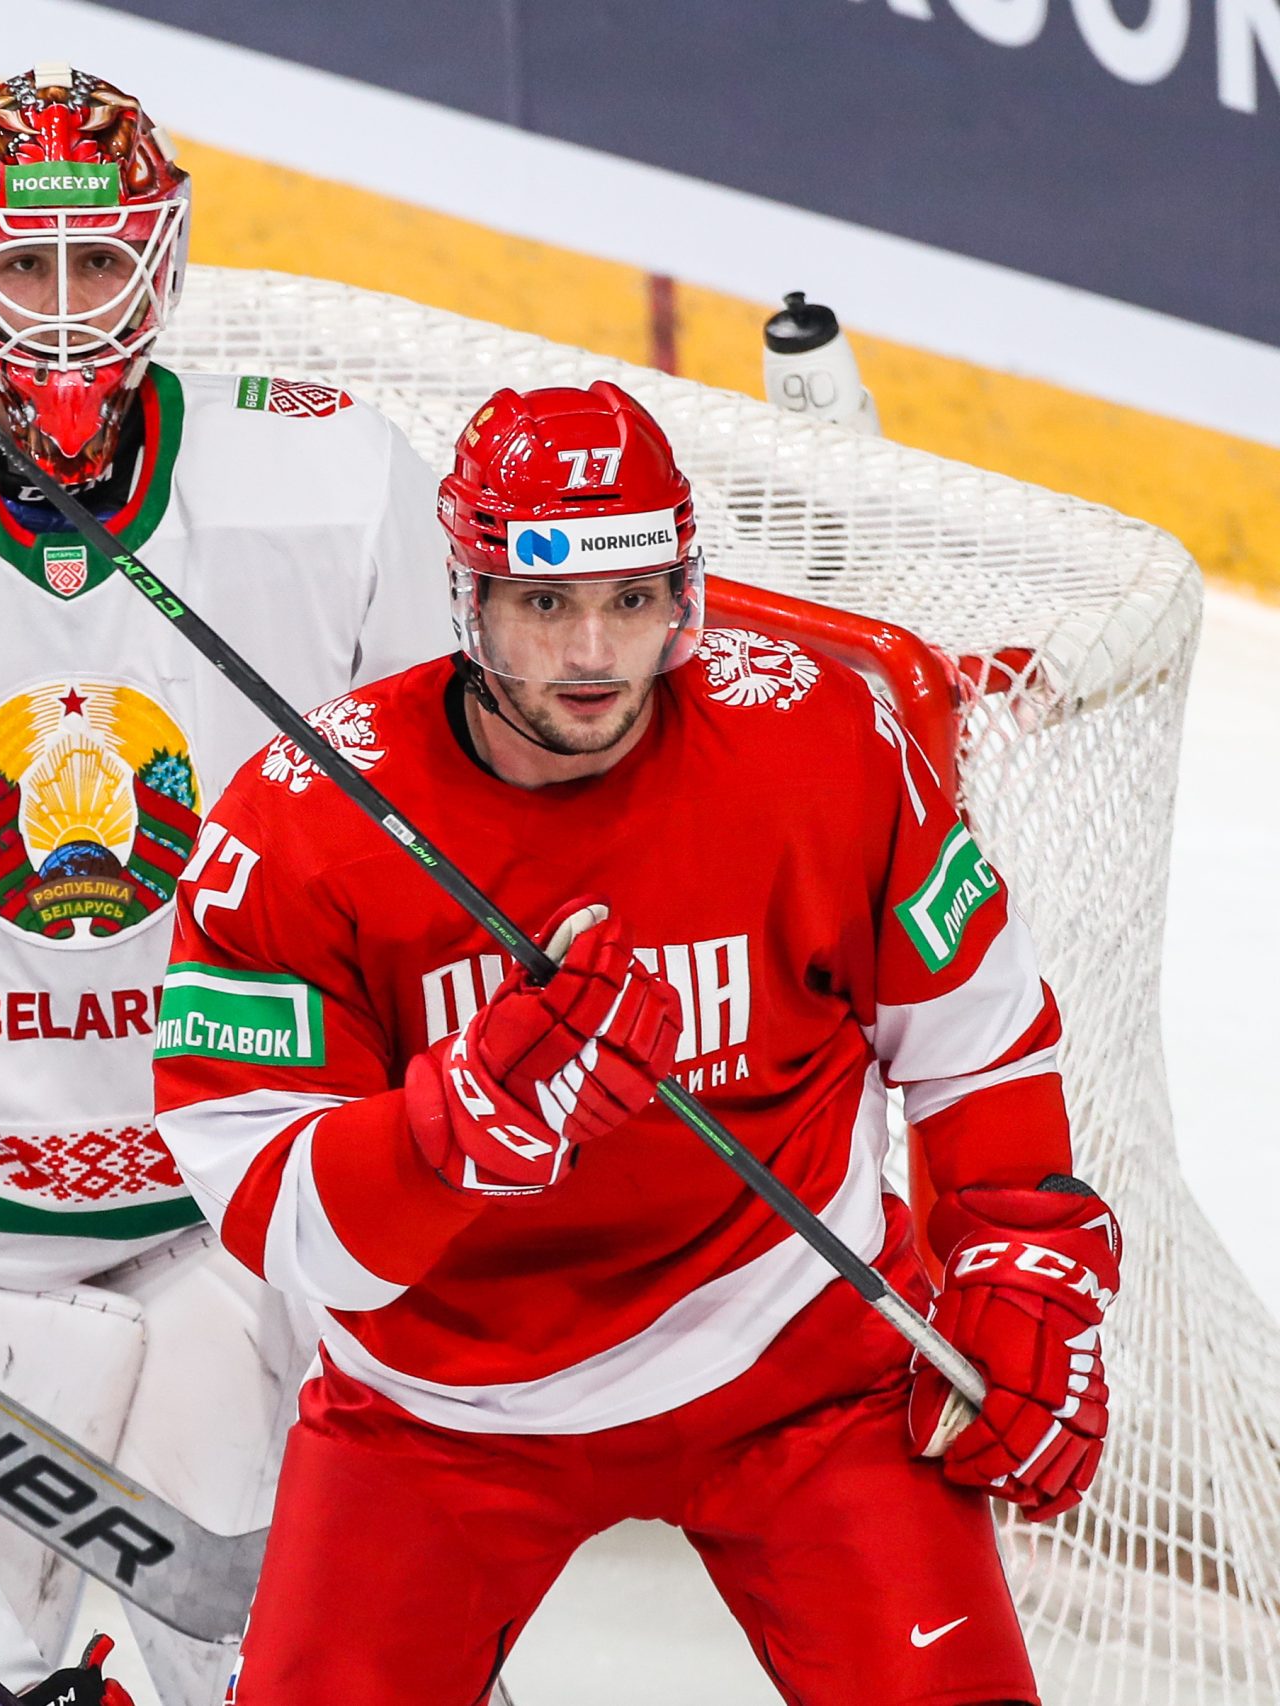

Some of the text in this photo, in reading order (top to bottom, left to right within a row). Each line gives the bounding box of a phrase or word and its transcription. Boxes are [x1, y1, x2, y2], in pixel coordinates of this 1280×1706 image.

[12, 176, 111, 192] HOCKEY.BY
[782, 369, 839, 413] 90
[557, 447, 622, 490] 77
[580, 529, 673, 552] NORNICKEL
[111, 555, 185, 619] CCM
[33, 881, 130, 905] РЭСПУБЛІКА
[40, 901, 125, 922] БЕЛАРУСЬ
[954, 1242, 1113, 1313] CCM
